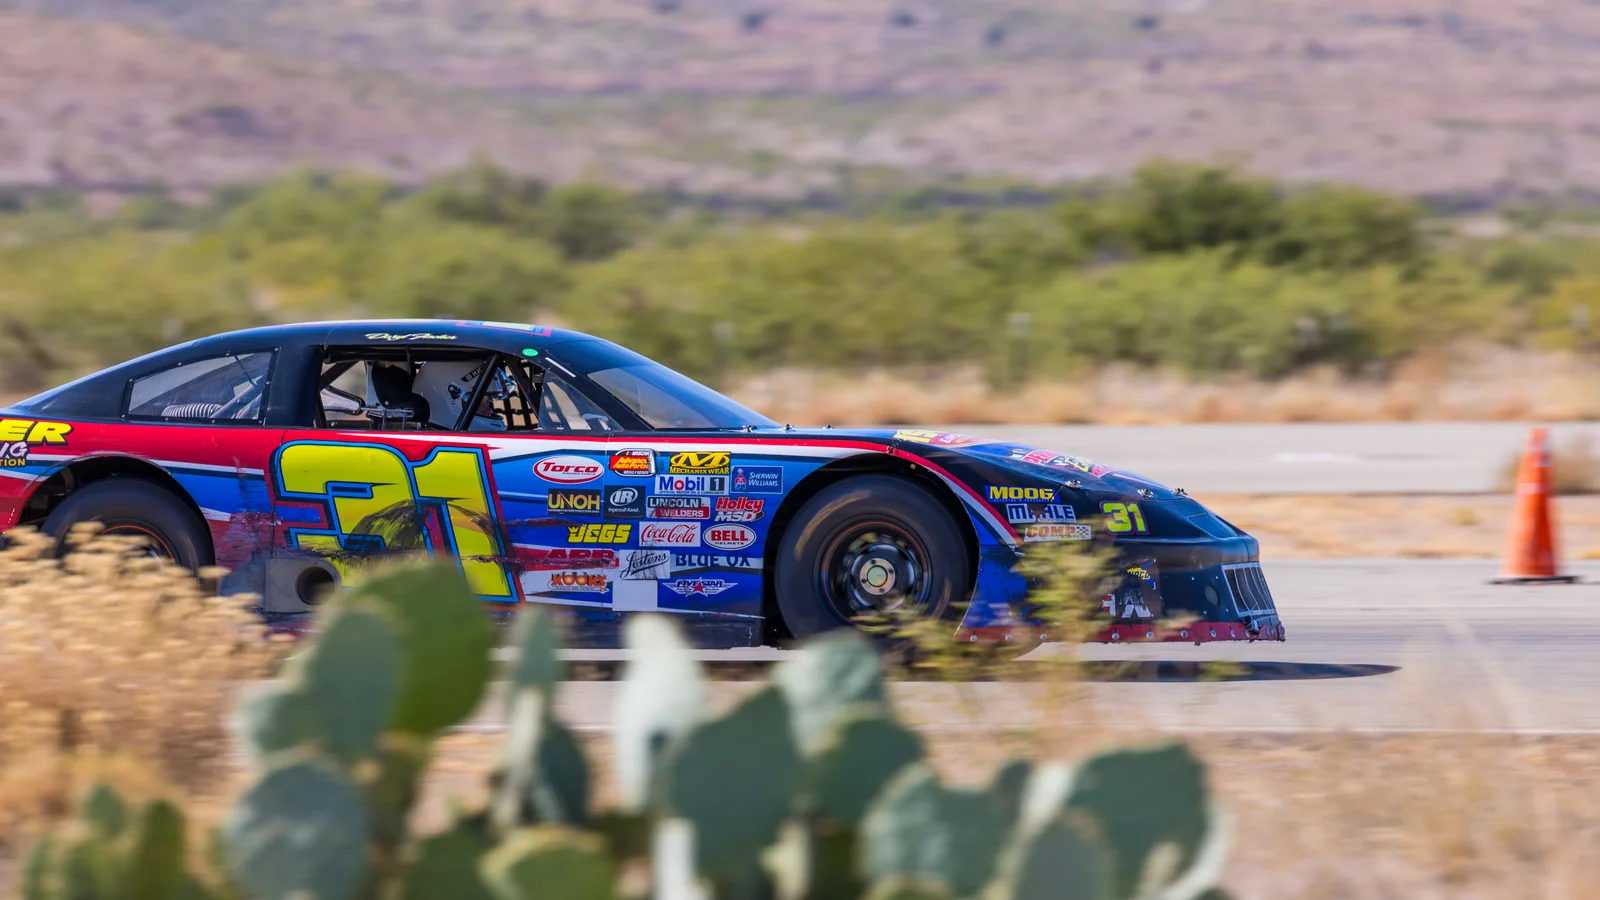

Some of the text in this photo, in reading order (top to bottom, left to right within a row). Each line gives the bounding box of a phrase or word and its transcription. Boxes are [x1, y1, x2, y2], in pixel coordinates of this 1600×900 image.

[543, 462, 599, 473] Torco
[670, 467, 730, 475] MECHANIX WEAR
[659, 476, 705, 491] Mobil
[614, 490, 634, 503] IR
[990, 486, 1055, 500] MOOG
[548, 492, 600, 510] UNOH
[649, 498, 699, 508] LINCOLN
[715, 497, 765, 513] Holley
[660, 509, 704, 518] WELDERS
[714, 511, 757, 522] MSD
[1102, 502, 1148, 532] 31
[274, 440, 519, 602] 31
[568, 524, 632, 543] JEGS
[711, 530, 748, 541] BELL
[1027, 526, 1076, 539] COMP
[620, 551, 669, 579] Jostens
[675, 553, 751, 567] BLUE OX
[551, 573, 607, 587] KOOKS
